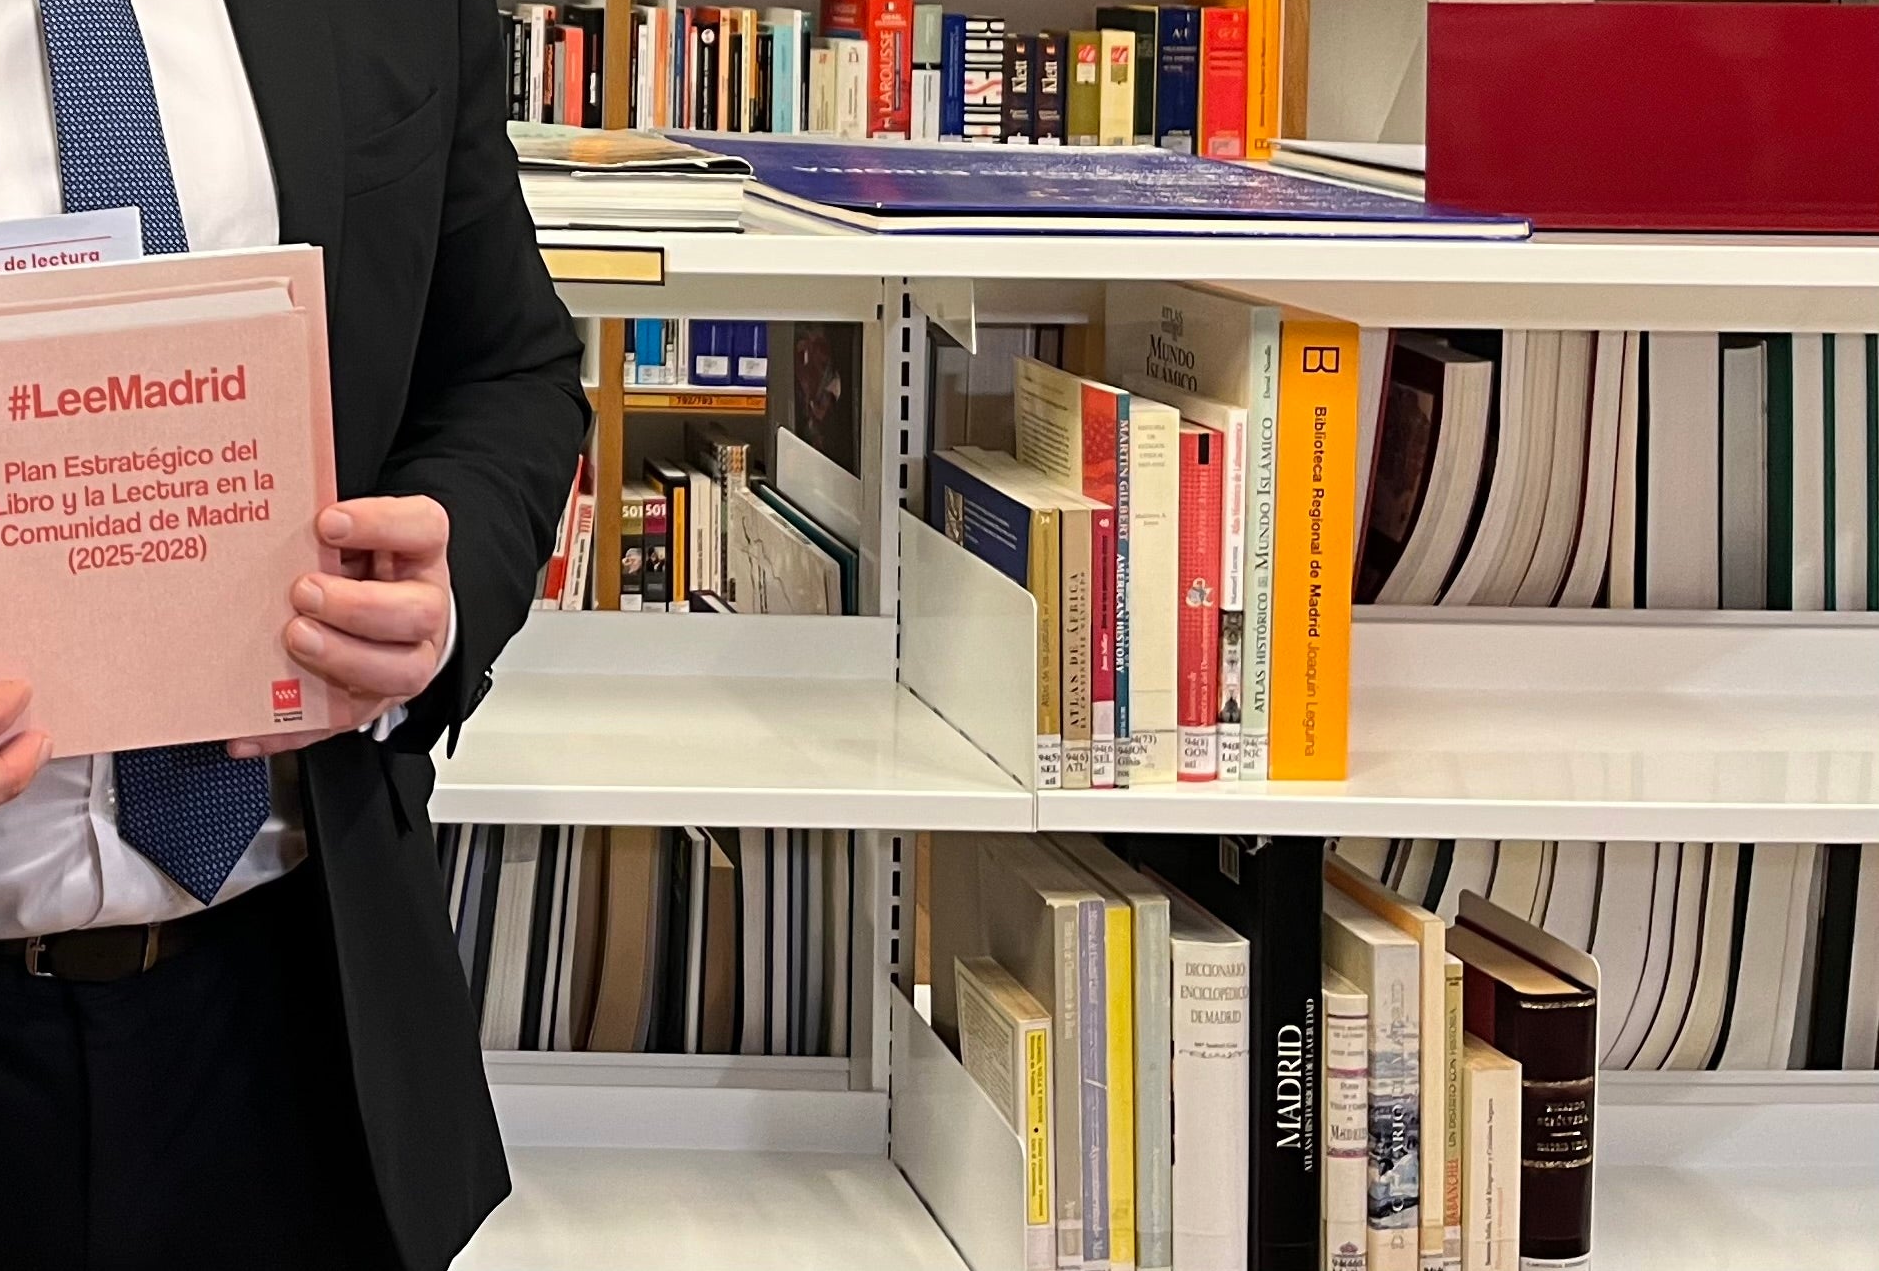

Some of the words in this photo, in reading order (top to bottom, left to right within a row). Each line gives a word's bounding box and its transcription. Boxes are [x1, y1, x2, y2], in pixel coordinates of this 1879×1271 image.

[878, 30, 894, 124] LAROUSSE
[4, 257, 26, 271] de
[31, 249, 100, 268] lectura
[1149, 334, 1195, 368] MUNDO
[7, 365, 246, 421] #LeeMadrid
[4, 460, 56, 484] Plan
[64, 446, 213, 481] Estratégico
[221, 440, 257, 464] del
[1119, 420, 1129, 477] MARTIN
[1256, 417, 1273, 496] ISLÁMICO
[1313, 406, 1327, 483] Biblioteca
[62, 495, 76, 515] y
[83, 486, 105, 508] la
[112, 478, 209, 504] Lectura
[216, 477, 246, 493] en
[254, 469, 274, 490] la
[622, 504, 643, 518] 501
[645, 503, 667, 517] 501
[0, 512, 141, 547] Comunidad
[149, 508, 179, 532] de
[187, 500, 270, 528] Madrid
[1255, 502, 1270, 570] MUNDO
[1309, 488, 1325, 555] Regional
[68, 535, 207, 574] (2025-2028)
[1310, 560, 1322, 578] de
[1066, 573, 1079, 634] ÁFRICA
[1116, 554, 1125, 618] AMERICAN
[1308, 584, 1322, 638] Madrid
[1116, 621, 1125, 673] HISTORY
[1253, 592, 1268, 664] HISTÓRICO
[1069, 647, 1079, 665] DE
[1069, 675, 1079, 727] ATLAS
[1254, 666, 1266, 713] ATLAS
[1185, 962, 1246, 977] DICCIONARIO
[1190, 1009, 1203, 1023] DE
[1204, 1009, 1242, 1024] MADRID
[1276, 1025, 1302, 1149] MADRID
